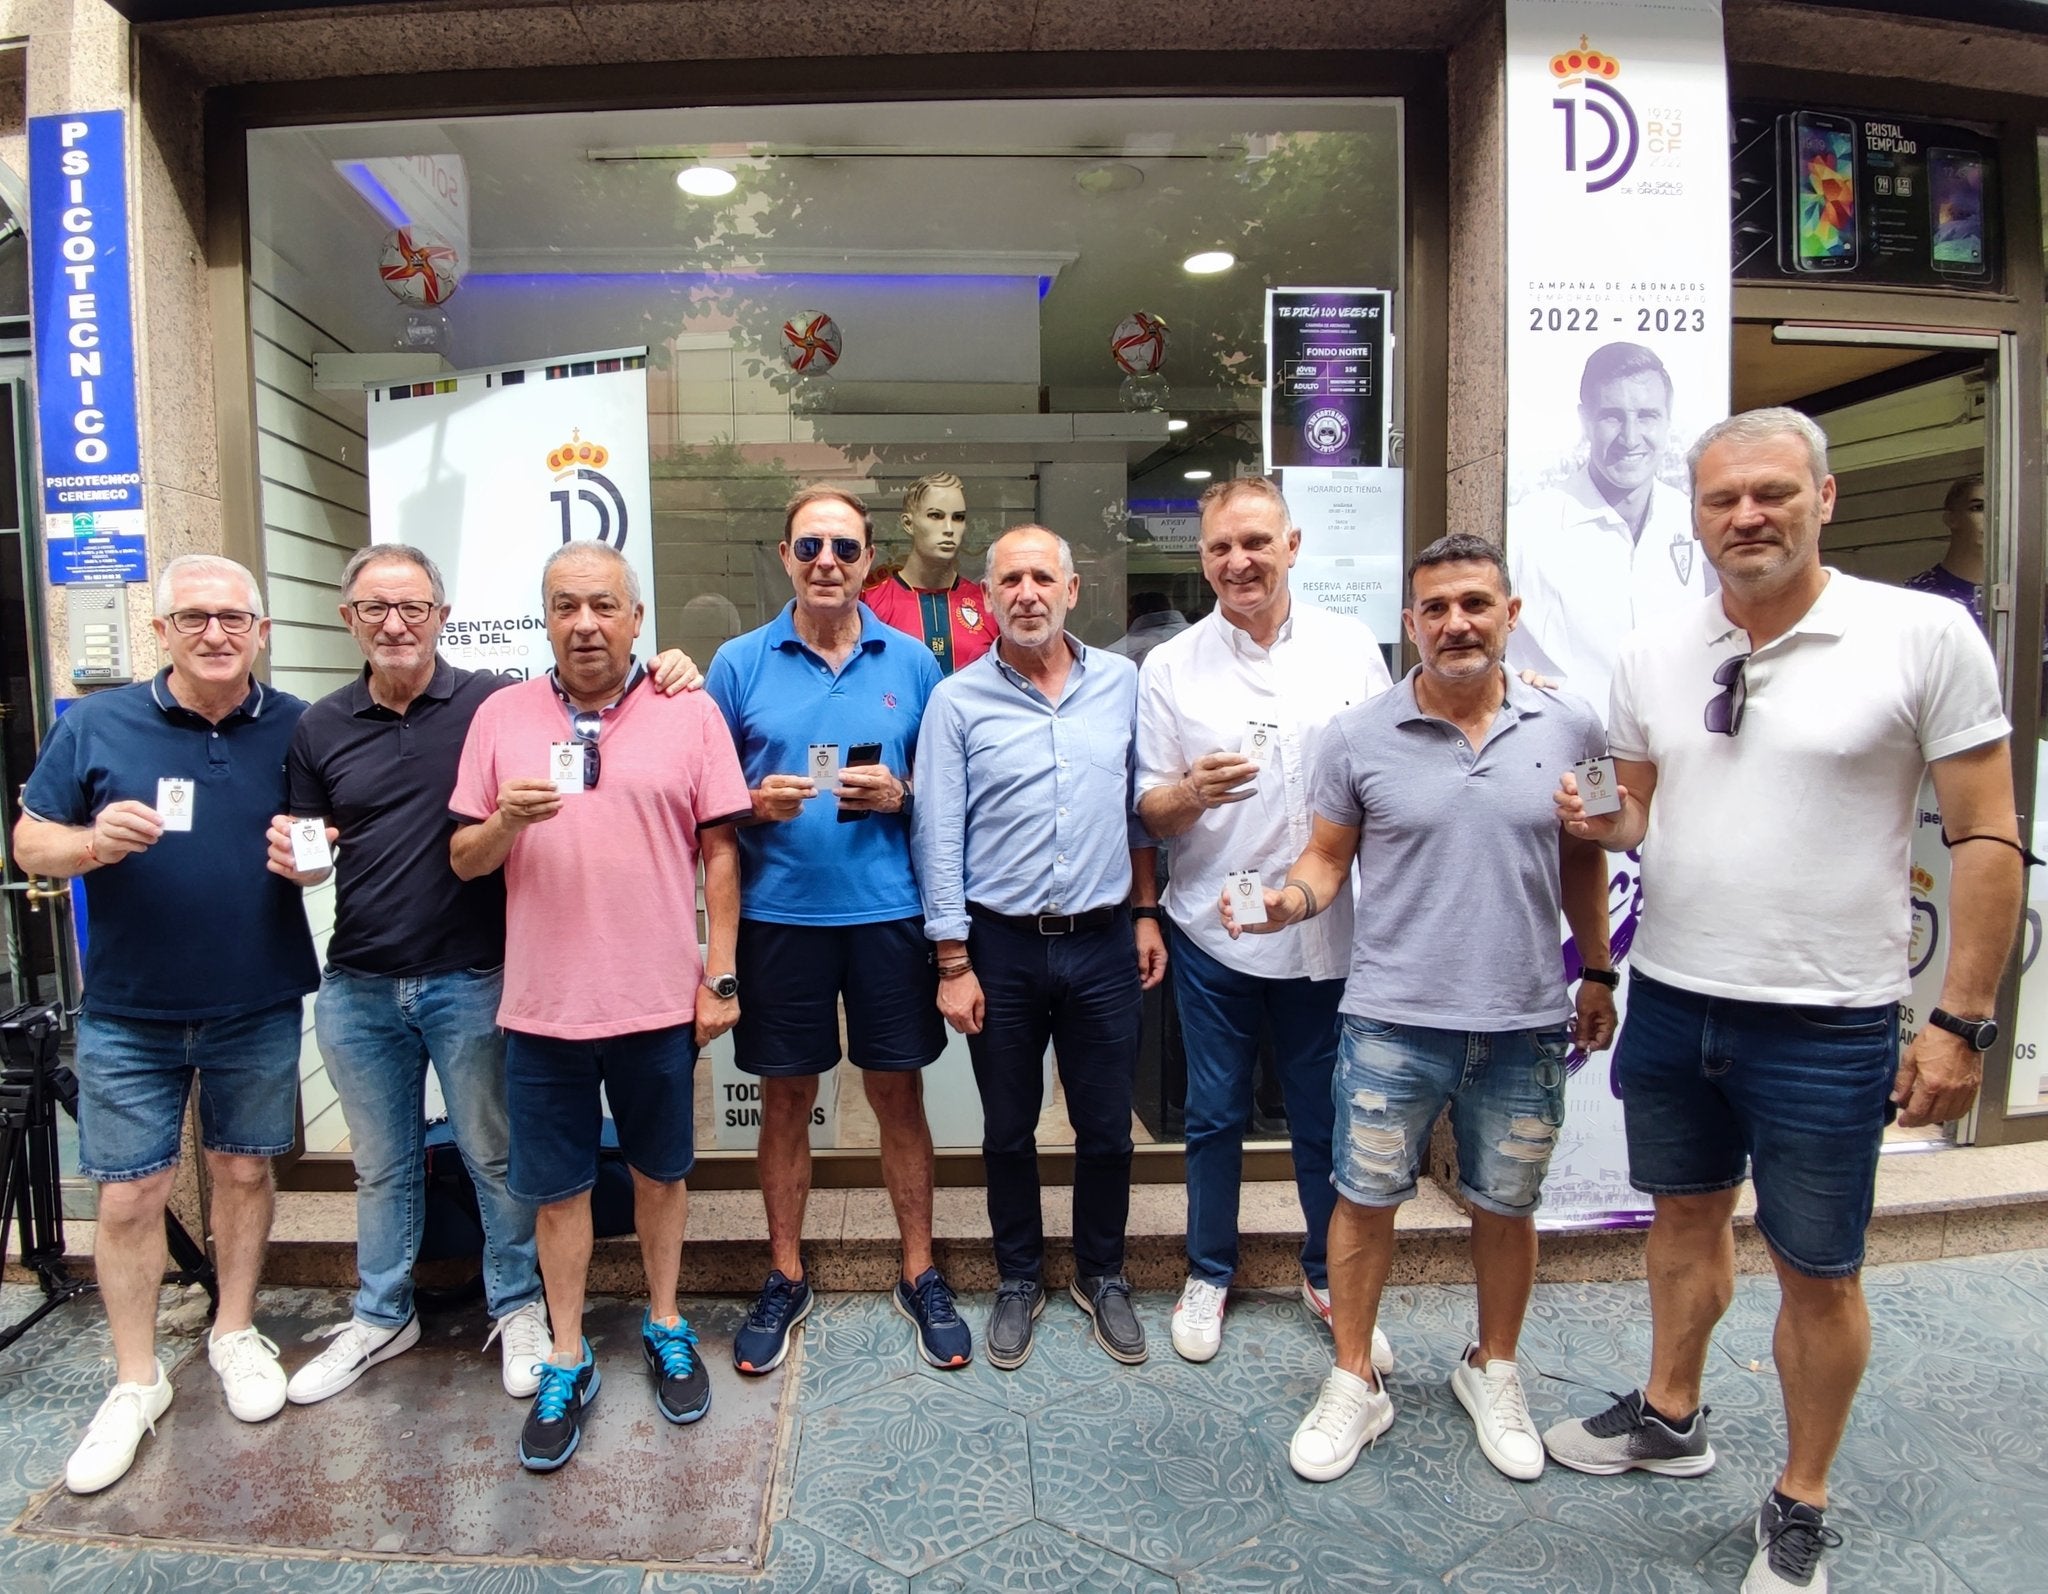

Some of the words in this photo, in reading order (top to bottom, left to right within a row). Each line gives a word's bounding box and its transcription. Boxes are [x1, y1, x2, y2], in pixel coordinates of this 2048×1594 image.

[1865, 122, 1904, 139] CRISTAL
[1648, 139, 1682, 153] CF
[1866, 136, 1917, 154] TEMPLADO
[61, 121, 108, 464] PSICOTECNICO
[1529, 281, 1596, 290] CAMPAÑA
[1605, 282, 1621, 290] DE
[1631, 282, 1706, 291] ABONADOS
[1278, 307, 1291, 318] TE
[1338, 307, 1368, 318] VECES
[1529, 307, 1599, 332] 2022
[1637, 308, 1705, 332] 2023
[1306, 347, 1337, 356] FONDO
[1338, 347, 1368, 356] NORTE
[46, 473, 140, 488] PSICOTECNICO
[58, 489, 128, 502] CEREMECO
[1307, 485, 1341, 493] HORARIO
[1343, 485, 1353, 493] DE
[1303, 582, 1341, 591] RESERVA
[1346, 581, 1382, 591] ABIERTA
[1317, 594, 1367, 602] CAMISETAS
[1326, 606, 1359, 614] ONLINE
[441, 615, 547, 633] SENTACIÓN
[479, 633, 512, 644] DEL
[723, 1083, 762, 1102] TOD
